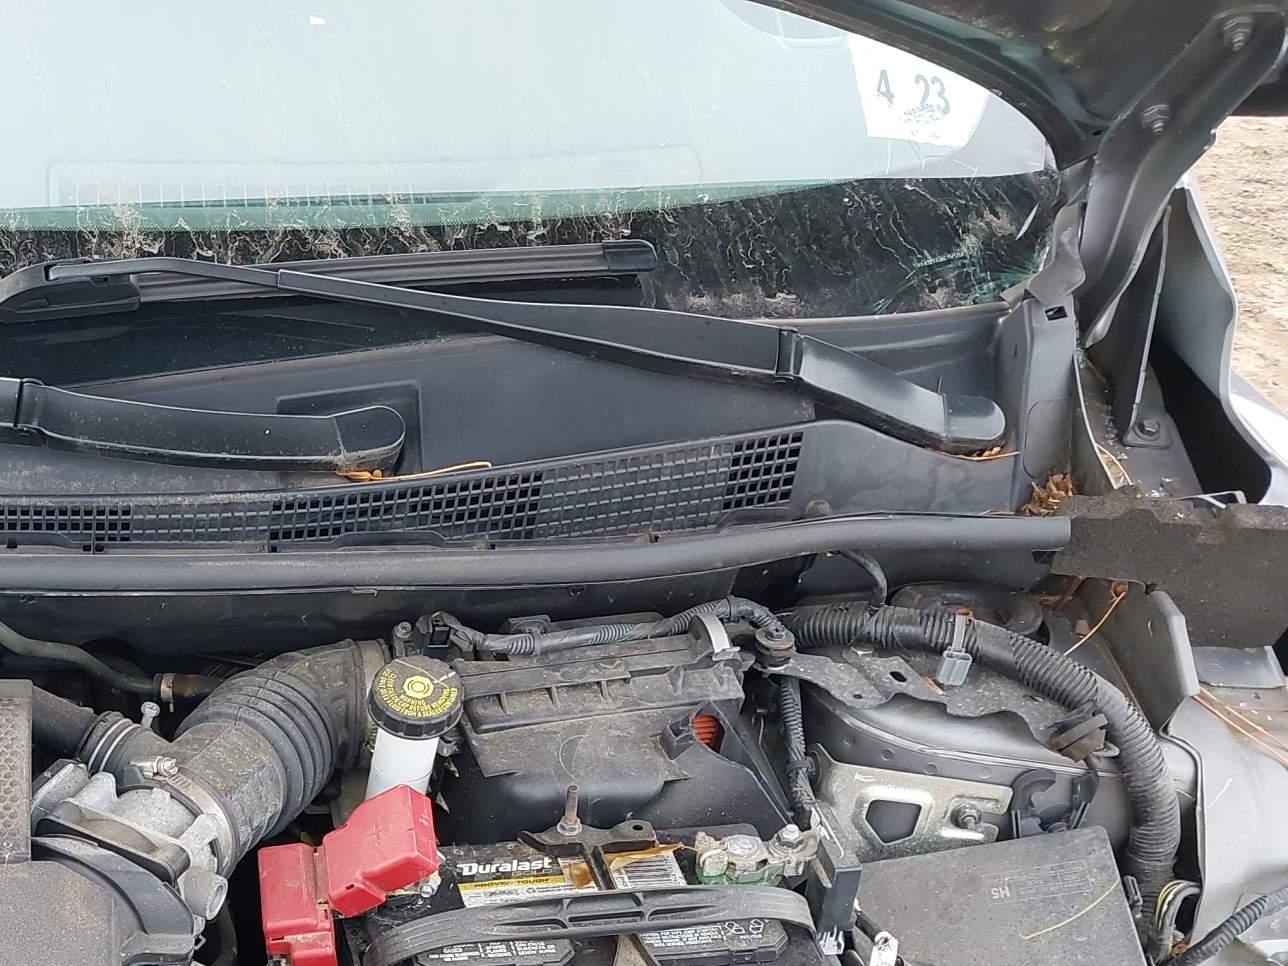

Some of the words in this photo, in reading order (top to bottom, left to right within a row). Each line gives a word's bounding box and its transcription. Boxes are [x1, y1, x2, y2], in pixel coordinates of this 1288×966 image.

[877, 70, 894, 107] 4
[915, 74, 950, 115] 23
[458, 857, 552, 876] Duralast
